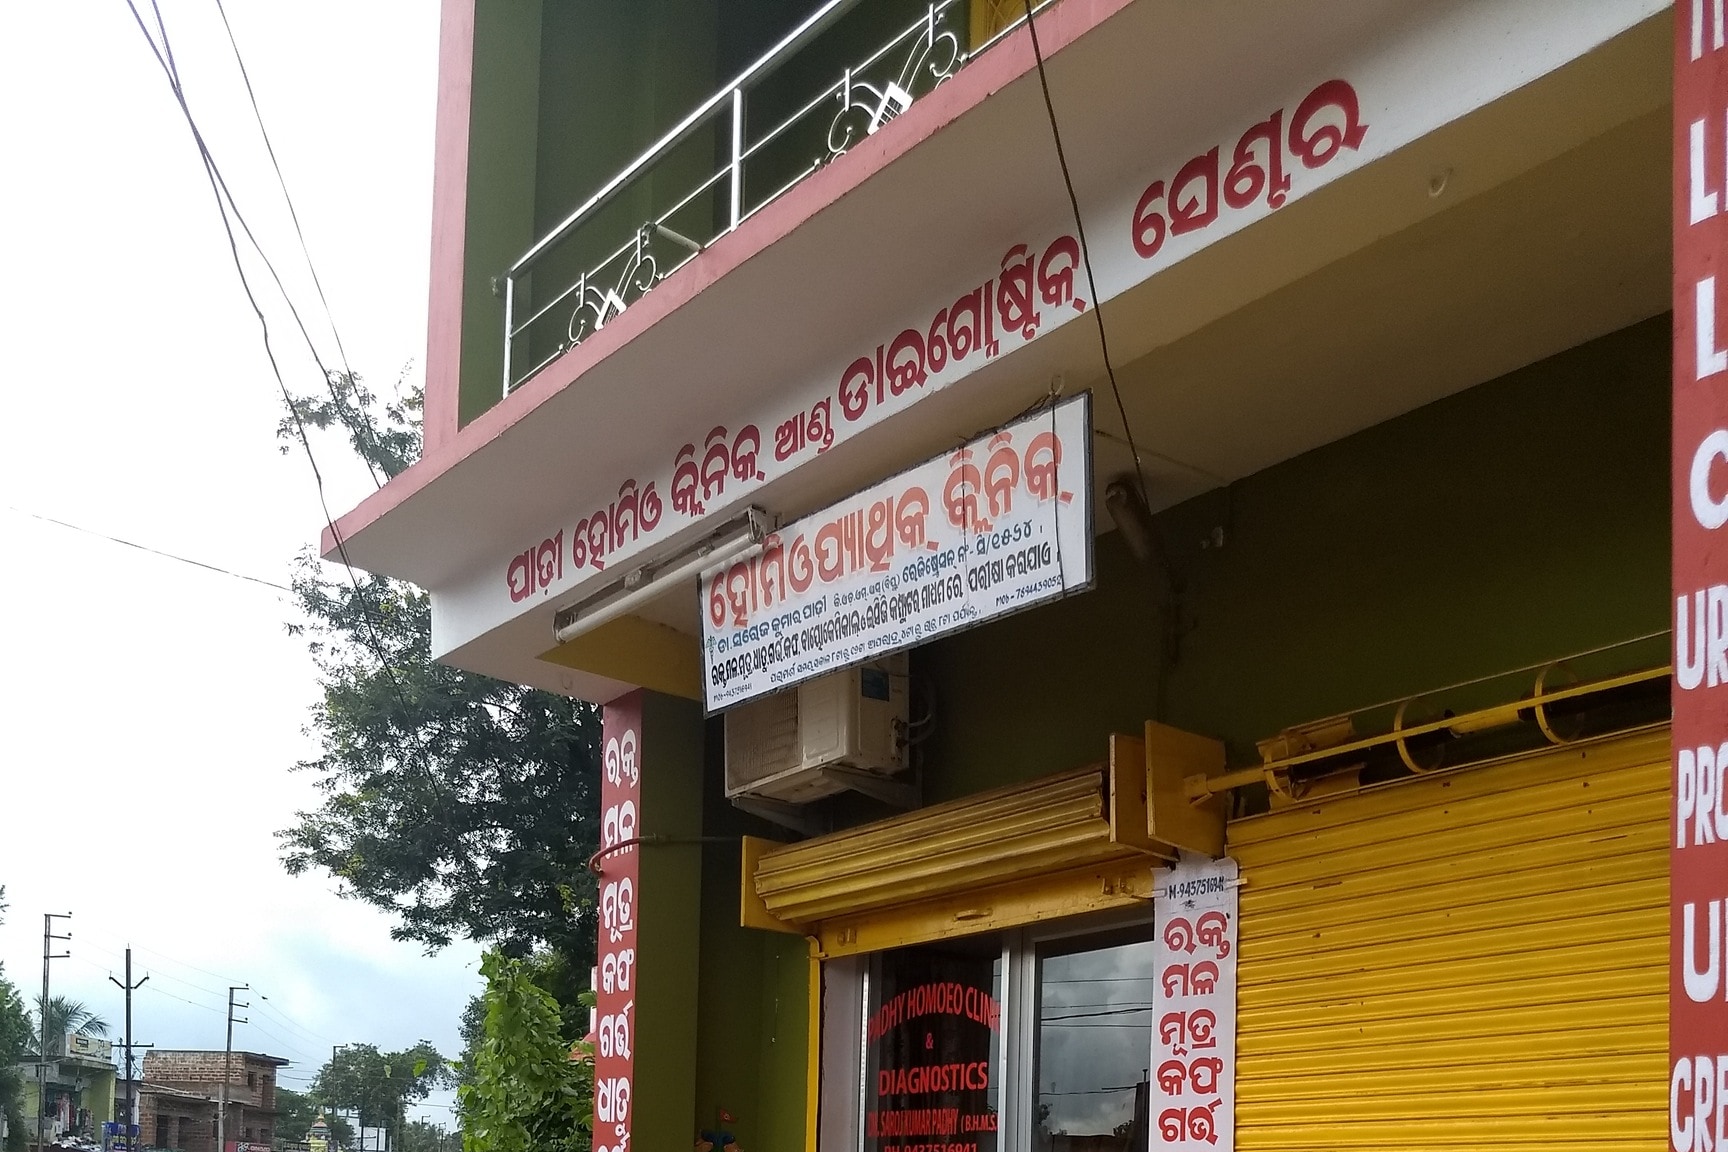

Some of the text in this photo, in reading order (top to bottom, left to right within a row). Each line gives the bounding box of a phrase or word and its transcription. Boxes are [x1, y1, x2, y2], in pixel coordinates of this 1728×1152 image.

[573, 479, 663, 571] ହୋମିଓ
[671, 424, 766, 517] କ୍ଲିନିକ୍
[942, 431, 1074, 534] କ୍ଲିନିକ୍
[605, 728, 639, 788] ରକ୍ତ
[602, 877, 634, 942] ମୂତ୍ର
[1163, 911, 1230, 960] ରକ୍ତ
[907, 982, 964, 1020] HOMOEO
[1161, 960, 1219, 999] ମଳ
[925, 1032, 934, 1049] &
[1159, 1008, 1217, 1057] ମୂତ୍ର
[878, 1062, 988, 1096] DIAGNOSTICS
[1157, 1056, 1224, 1097] କଫ
[1158, 1097, 1223, 1145] ଗର୍ଭ
